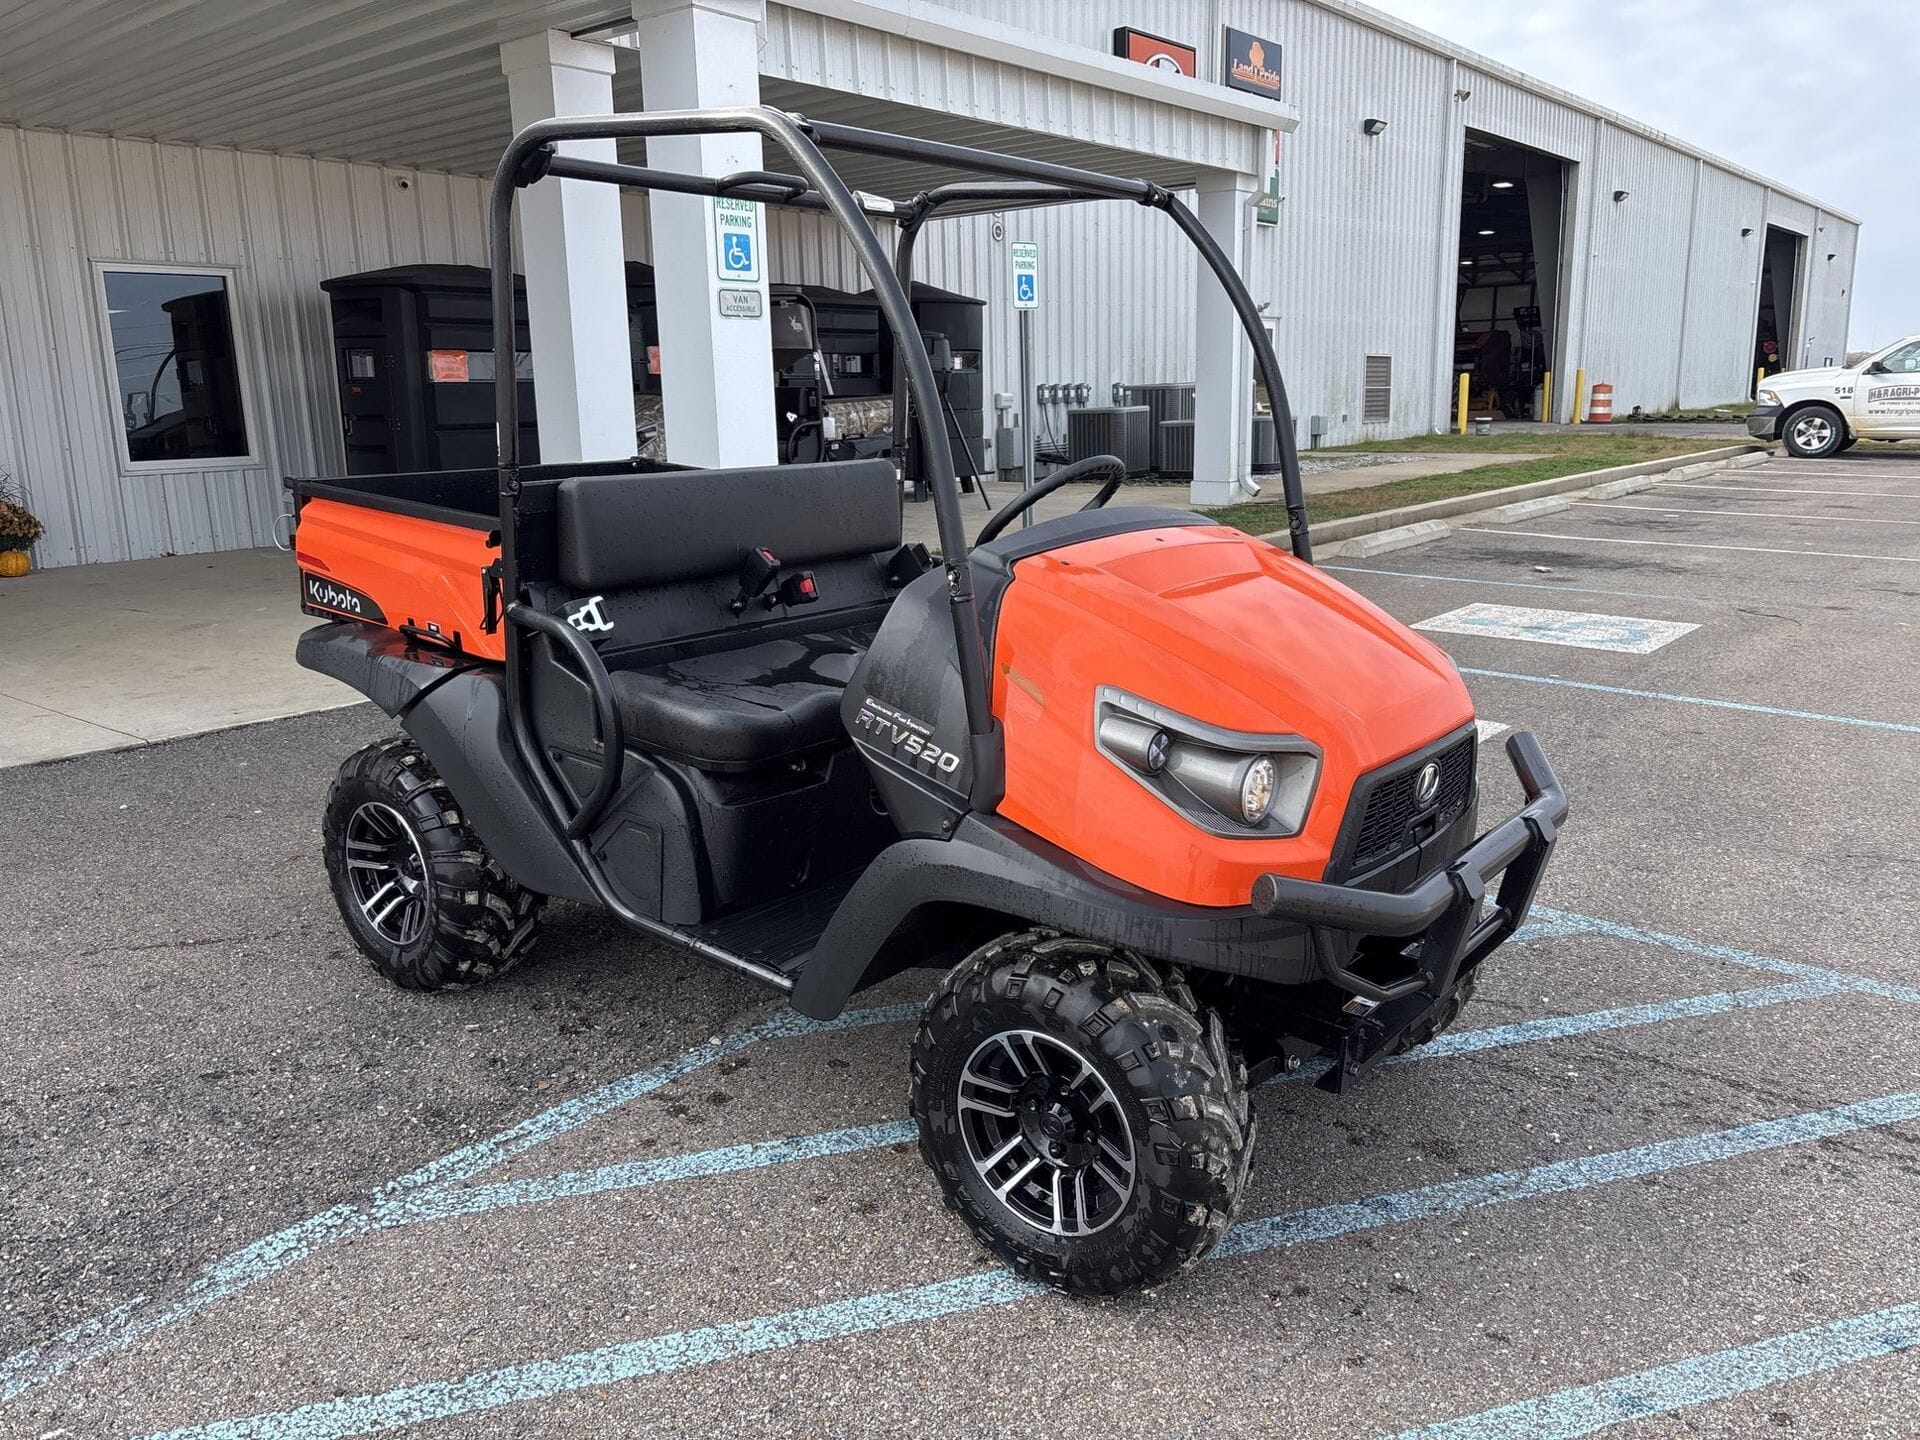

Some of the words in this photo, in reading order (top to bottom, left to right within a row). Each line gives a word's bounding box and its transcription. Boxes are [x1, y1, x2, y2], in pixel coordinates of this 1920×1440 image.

[1233, 58, 1253, 76] Land
[1258, 65, 1280, 83] Pride
[716, 198, 754, 212] RESERVED
[720, 213, 752, 228] PARKING
[1013, 248, 1035, 258] RESERVED
[1015, 260, 1035, 270] PARKING
[733, 295, 749, 304] VAN
[726, 304, 756, 313] ACCESSIBLE
[1834, 386, 1854, 394] 518
[309, 579, 361, 614] Kubota
[865, 697, 893, 717] Electronic
[855, 708, 960, 773] RTV520
